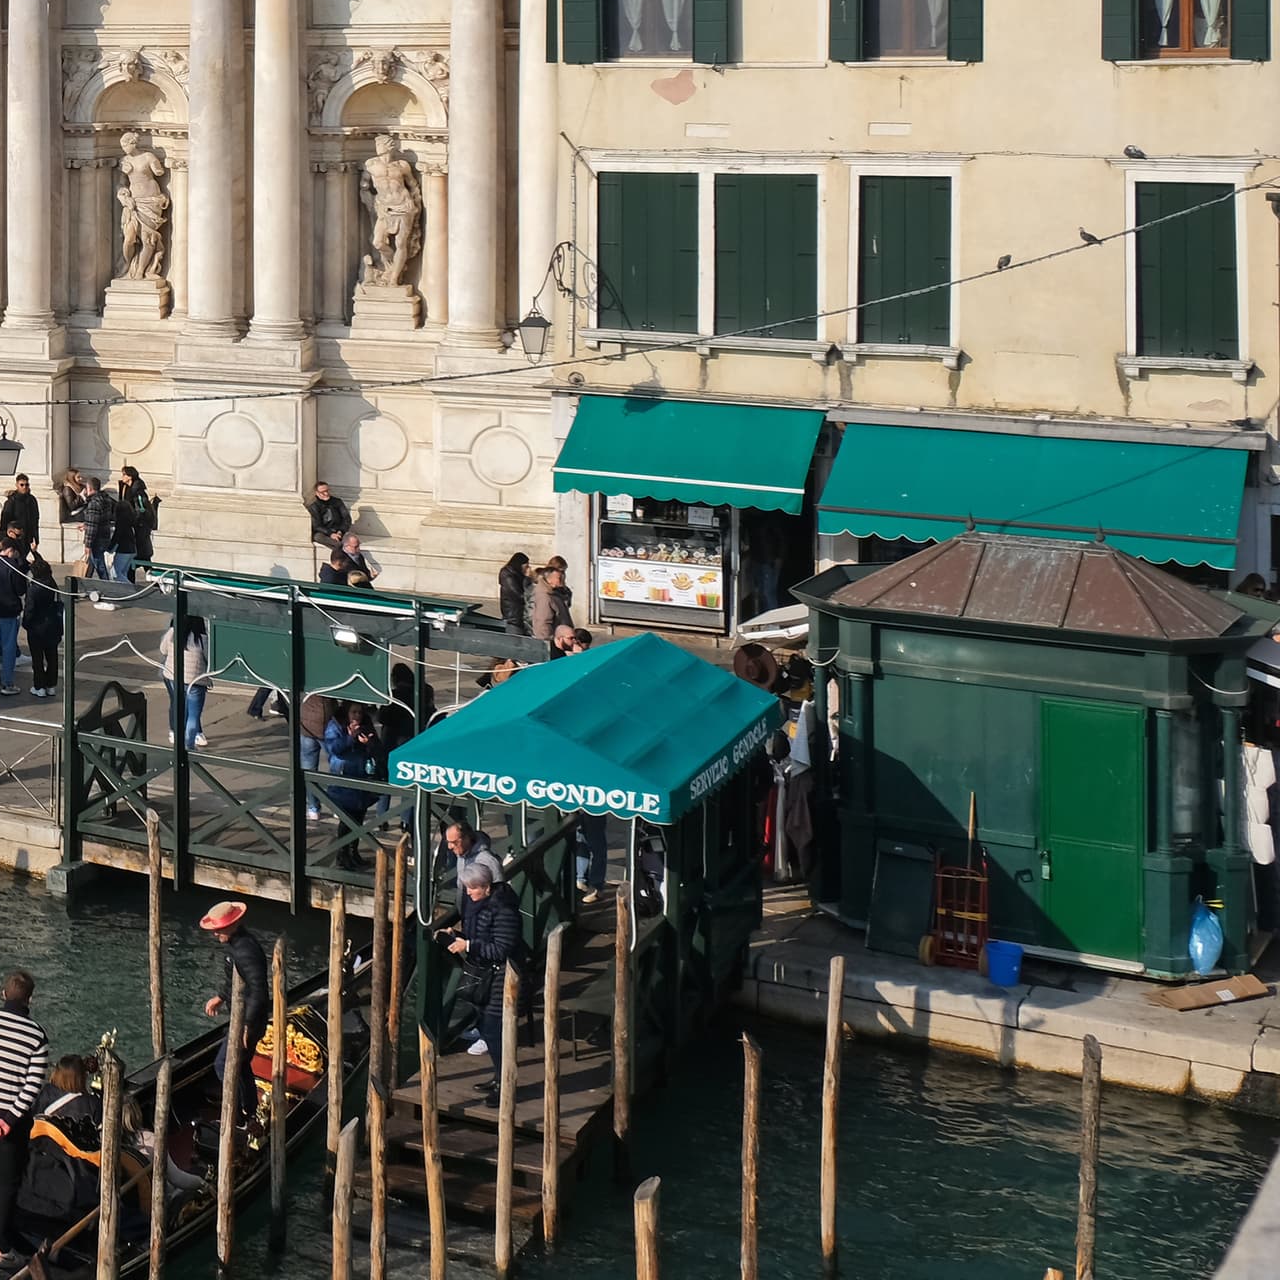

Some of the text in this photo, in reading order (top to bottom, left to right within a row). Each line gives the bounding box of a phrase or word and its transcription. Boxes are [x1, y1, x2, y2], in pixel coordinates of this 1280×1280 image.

[395, 760, 662, 817] SERVIZIO GONDOLE
[689, 717, 769, 802] SERVIZIO GONDOLE
